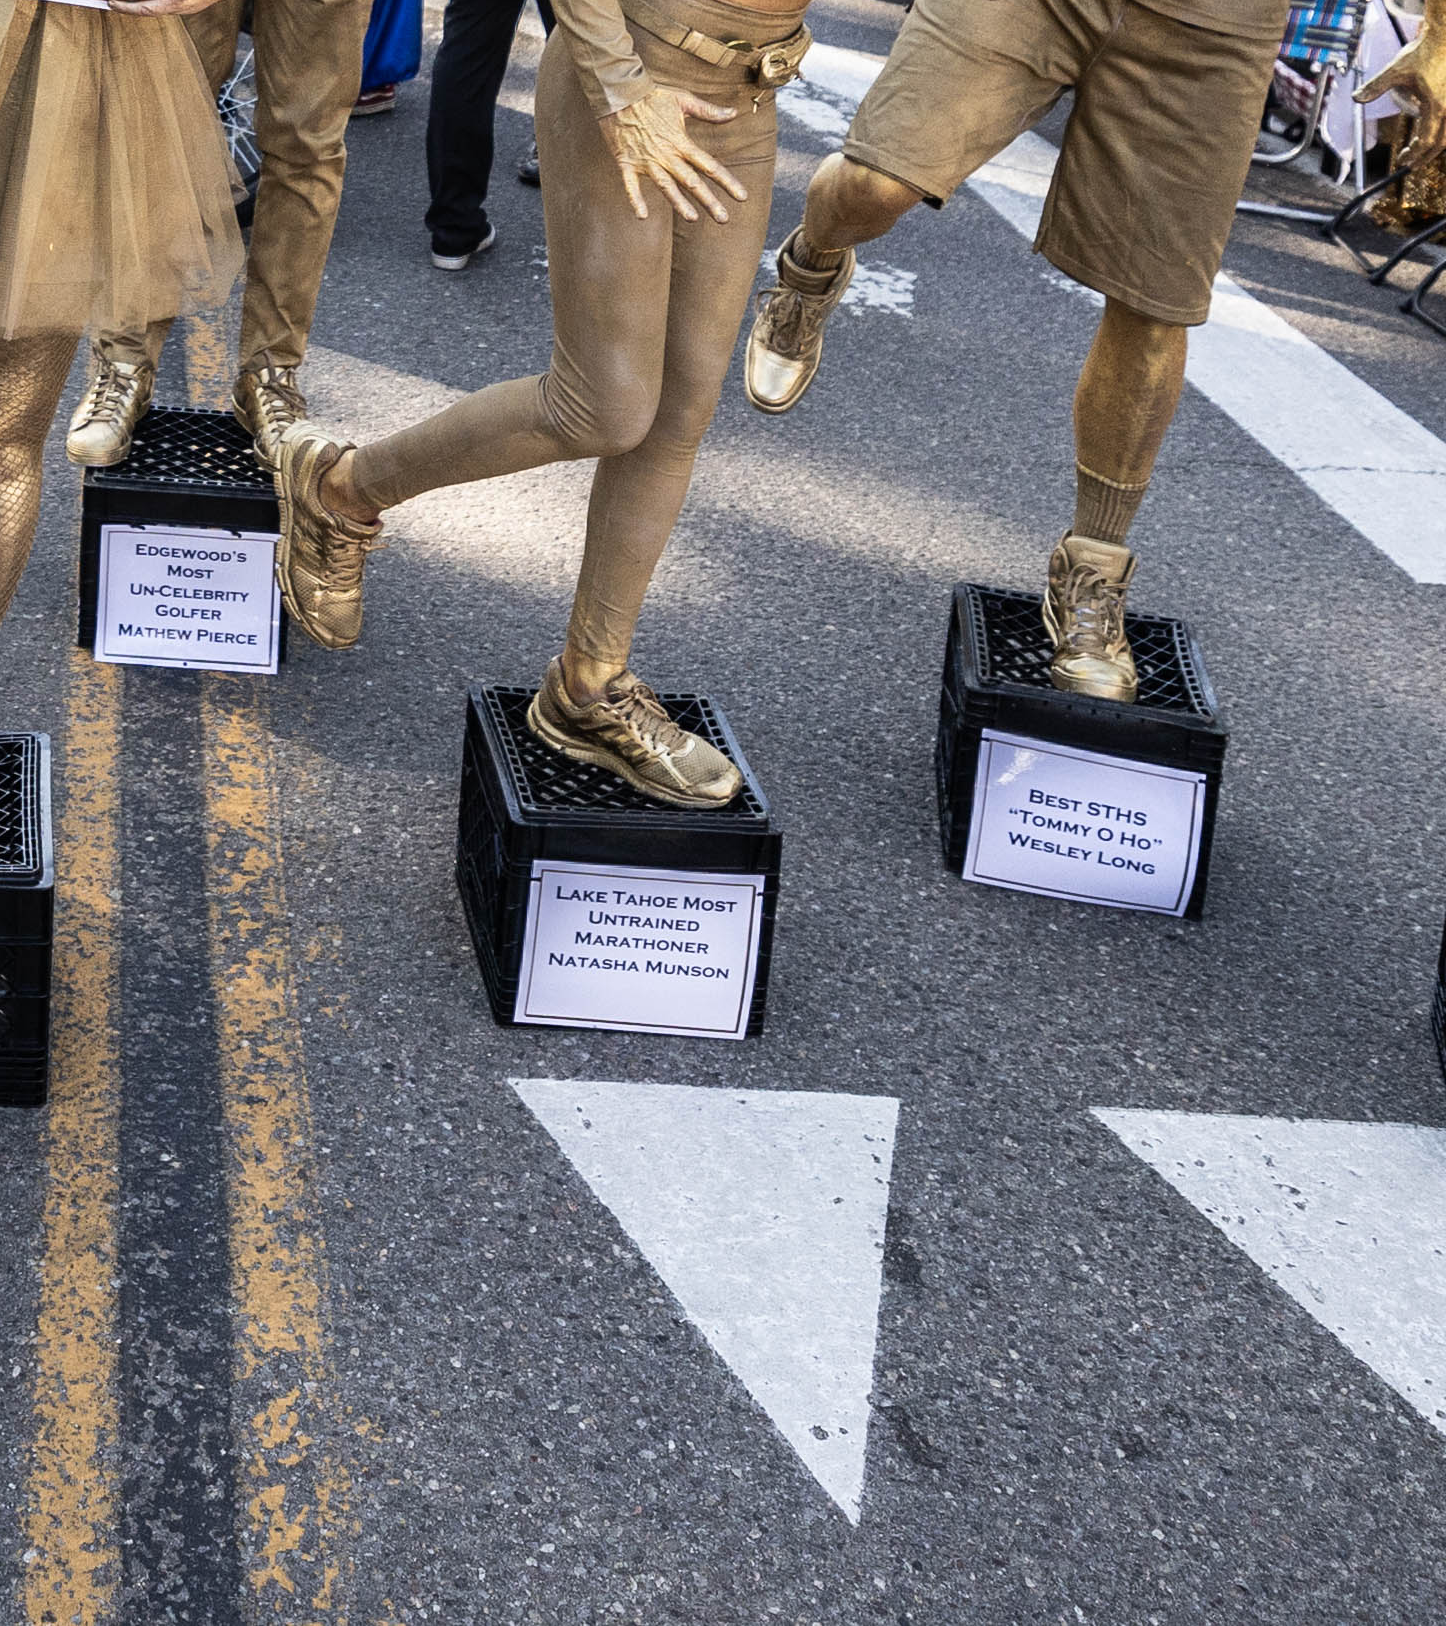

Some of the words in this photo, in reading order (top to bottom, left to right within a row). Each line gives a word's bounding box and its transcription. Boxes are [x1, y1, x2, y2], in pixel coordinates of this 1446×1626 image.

[135, 543, 247, 563] EDGEWOOD'S
[166, 564, 215, 580] MOST
[130, 582, 250, 603] UN-CELEBRITY
[155, 604, 222, 621] GOLFER
[118, 623, 193, 641] MATHEW
[197, 628, 258, 646] PIERCE
[1028, 788, 1083, 812] BEST
[1086, 801, 1147, 827] STHS
[1097, 827, 1114, 842] O
[1008, 831, 1093, 861] WESLEY
[1097, 850, 1156, 875] LONG
[555, 885, 609, 904] LAKE
[612, 890, 679, 909] TAHOE
[683, 896, 738, 913] MOST
[588, 910, 700, 932] UNTRAINED
[574, 931, 709, 955] MARATHONER
[548, 952, 639, 972] NATASHA
[645, 960, 730, 979] MUNSON
